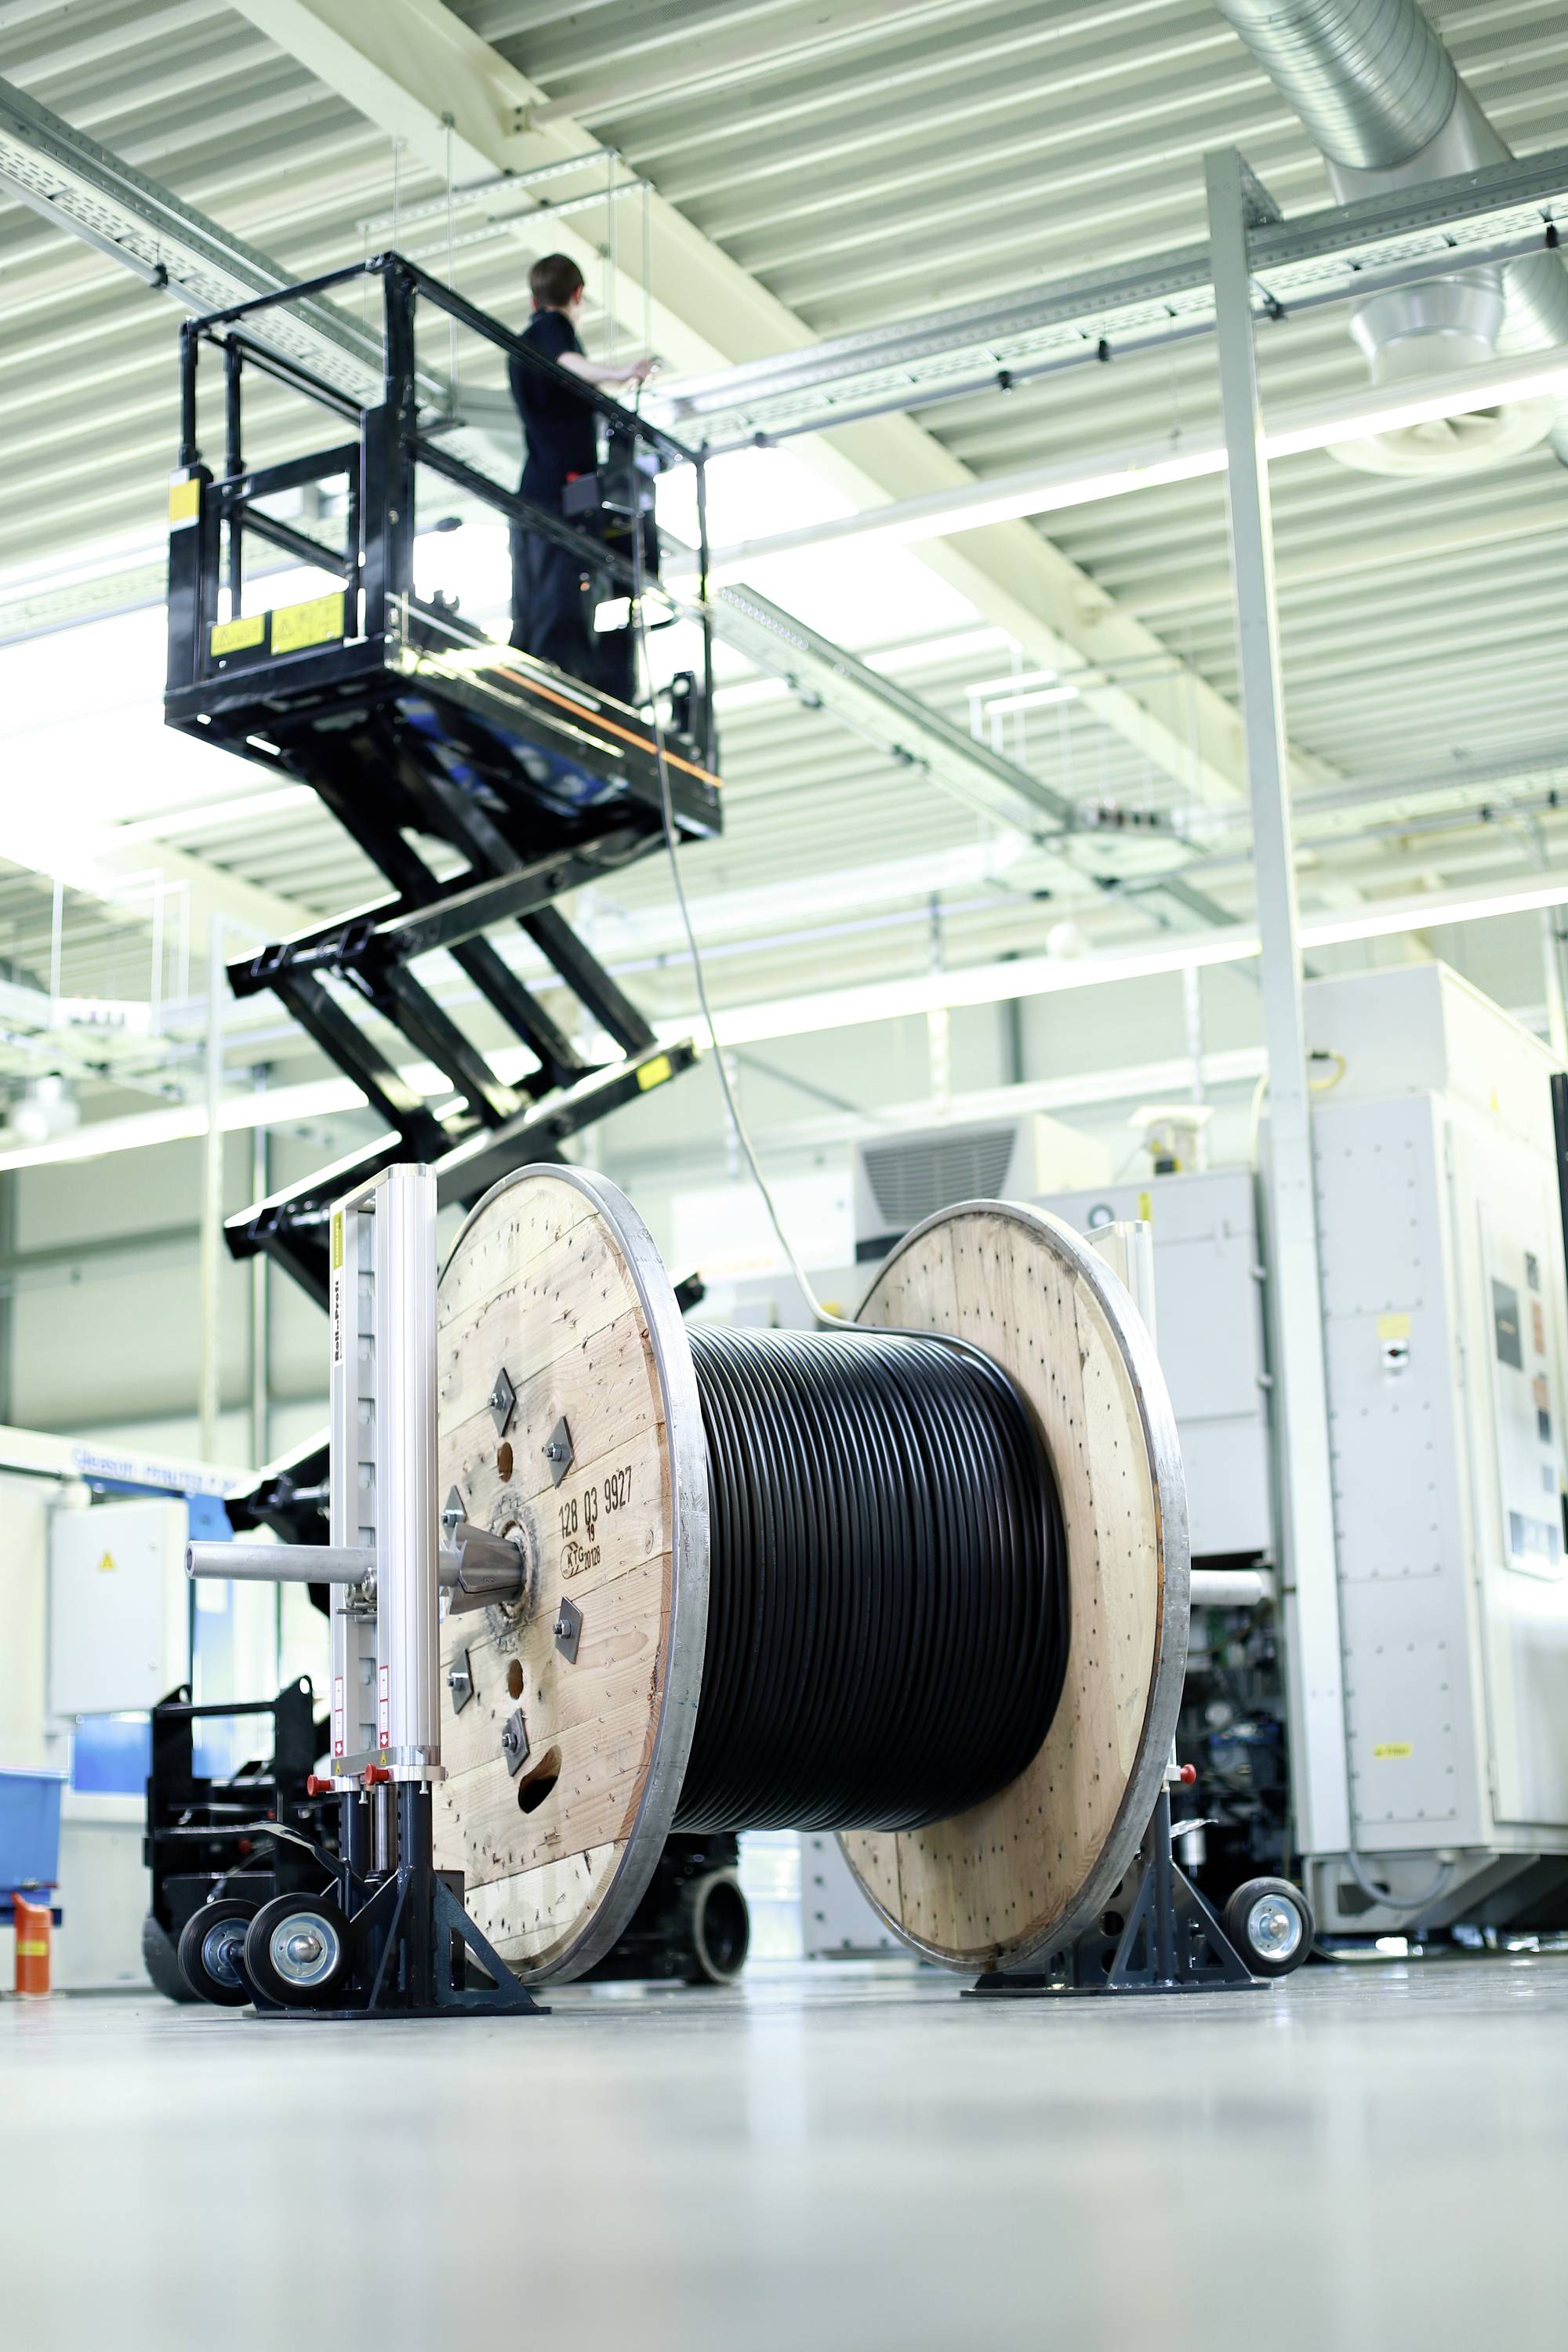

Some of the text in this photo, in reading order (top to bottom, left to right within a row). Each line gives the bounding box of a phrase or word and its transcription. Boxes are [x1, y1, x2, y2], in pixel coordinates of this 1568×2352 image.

[559, 1465, 632, 1539] 128 03 9927
[587, 1523, 595, 1543] 19
[567, 1545, 601, 1570] KTG 20128
